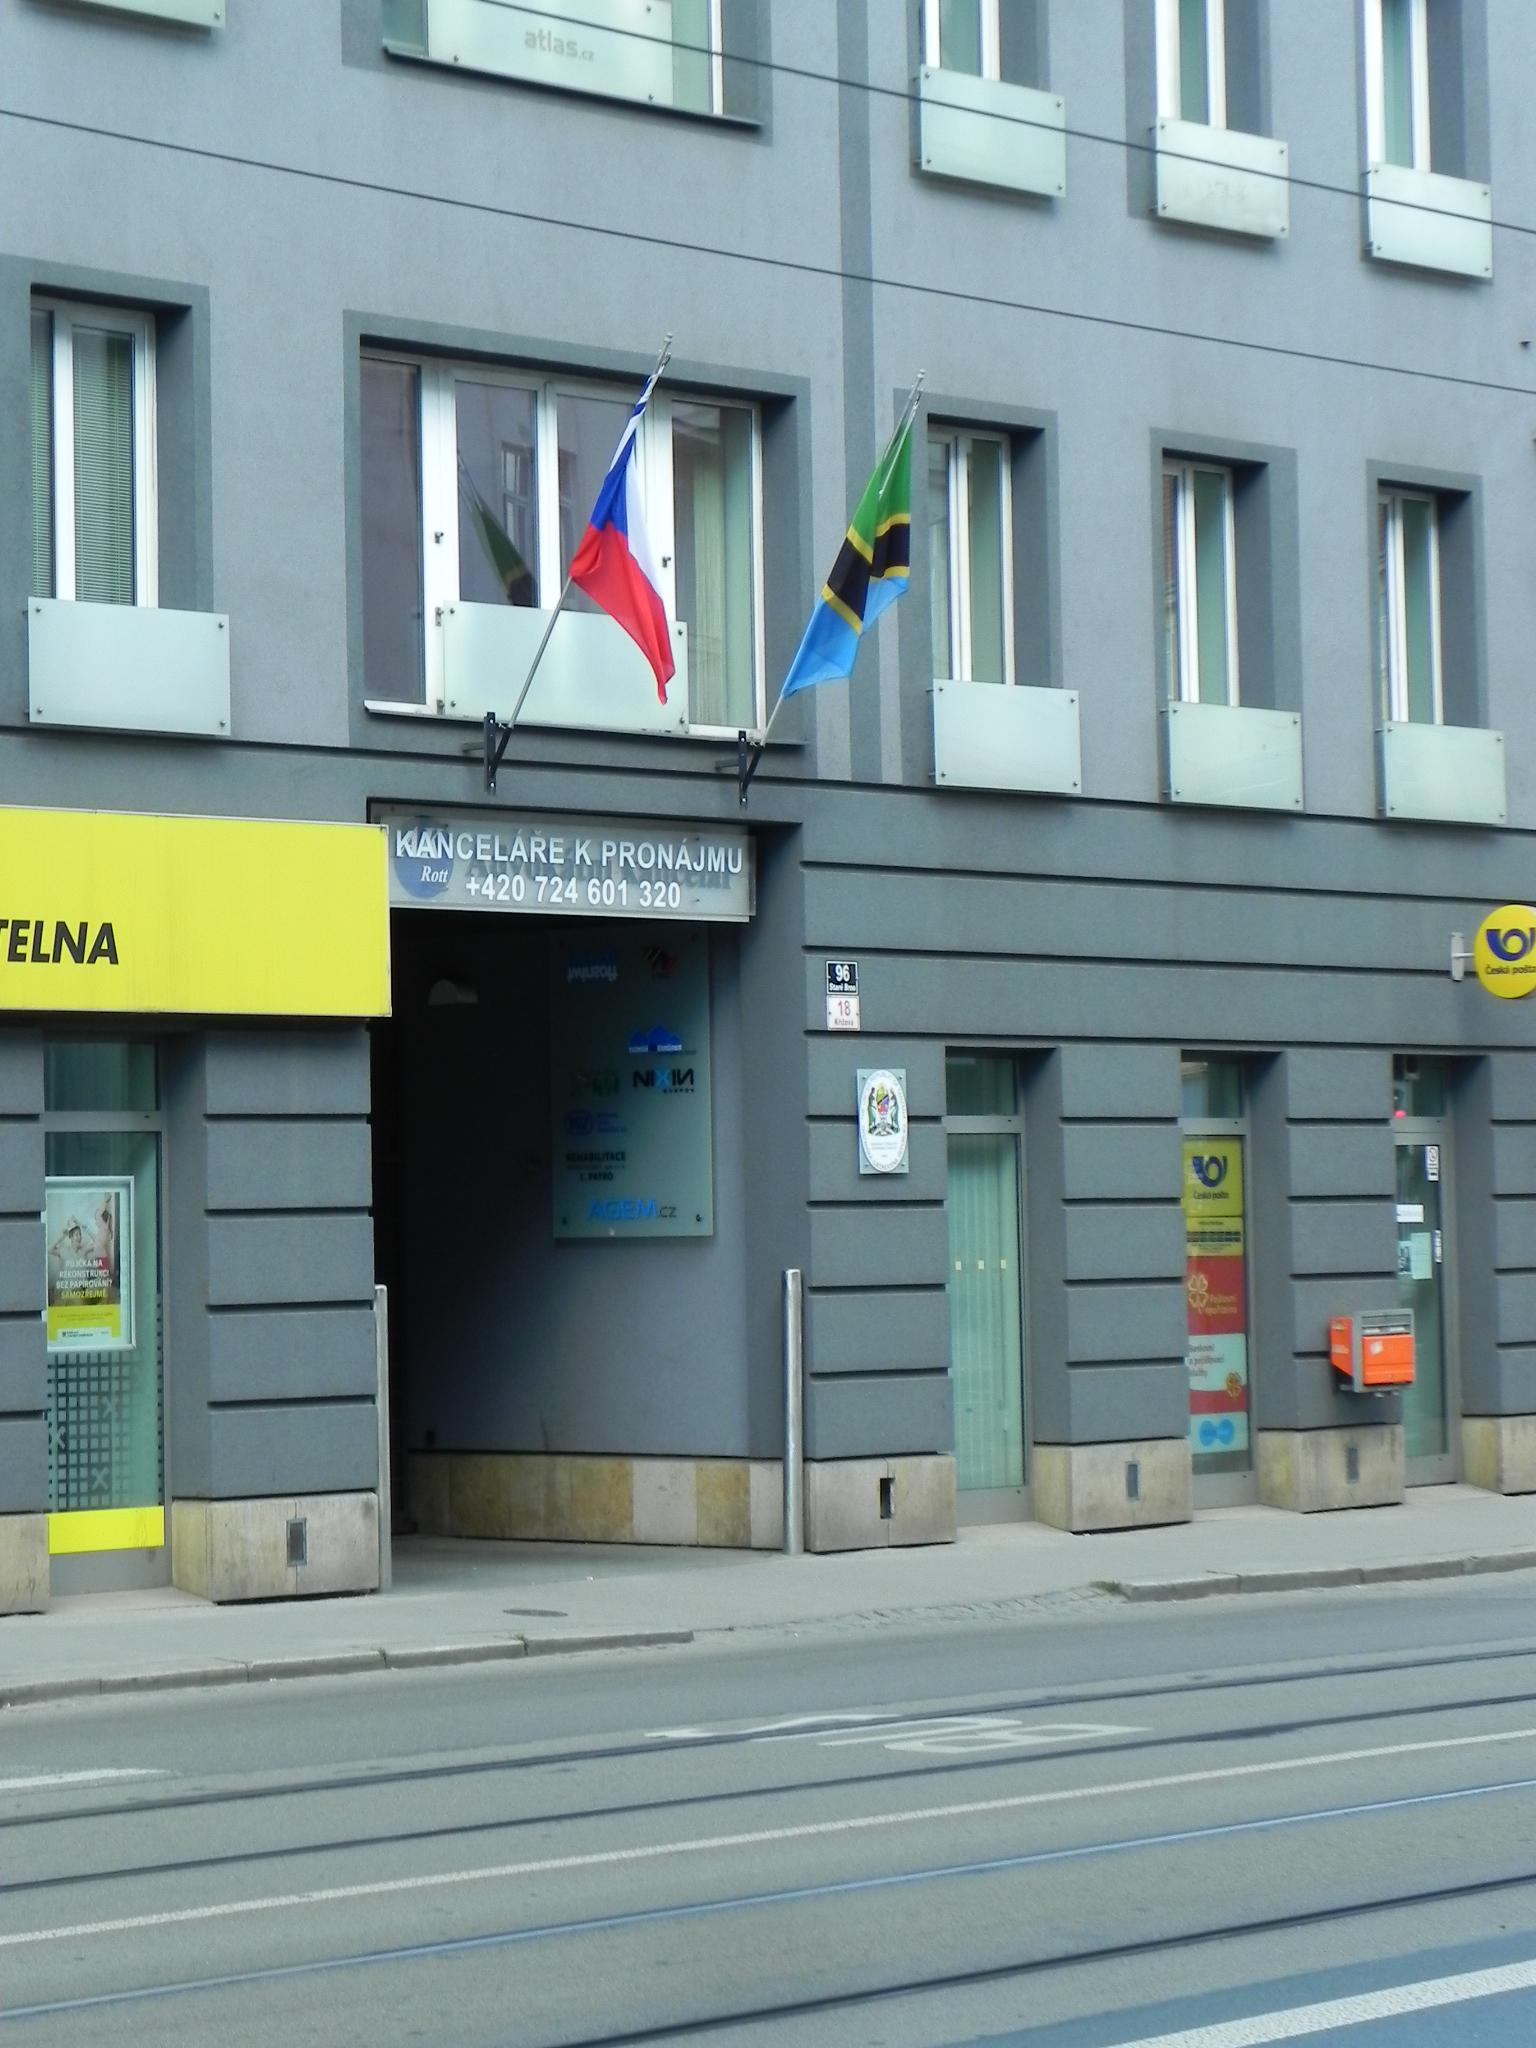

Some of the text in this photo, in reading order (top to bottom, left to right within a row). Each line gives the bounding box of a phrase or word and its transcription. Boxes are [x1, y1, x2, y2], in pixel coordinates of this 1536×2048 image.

[523, 28, 594, 62] atlas.cz
[396, 828, 742, 874] KANCELÁŘE K PRONÁJMU
[420, 865, 449, 884] Rott
[465, 873, 526, 902] +420
[534, 875, 578, 904] 724
[587, 878, 628, 906] 601
[639, 880, 681, 908] 320
[835, 964, 851, 983] 96
[837, 1000, 852, 1017] 18
